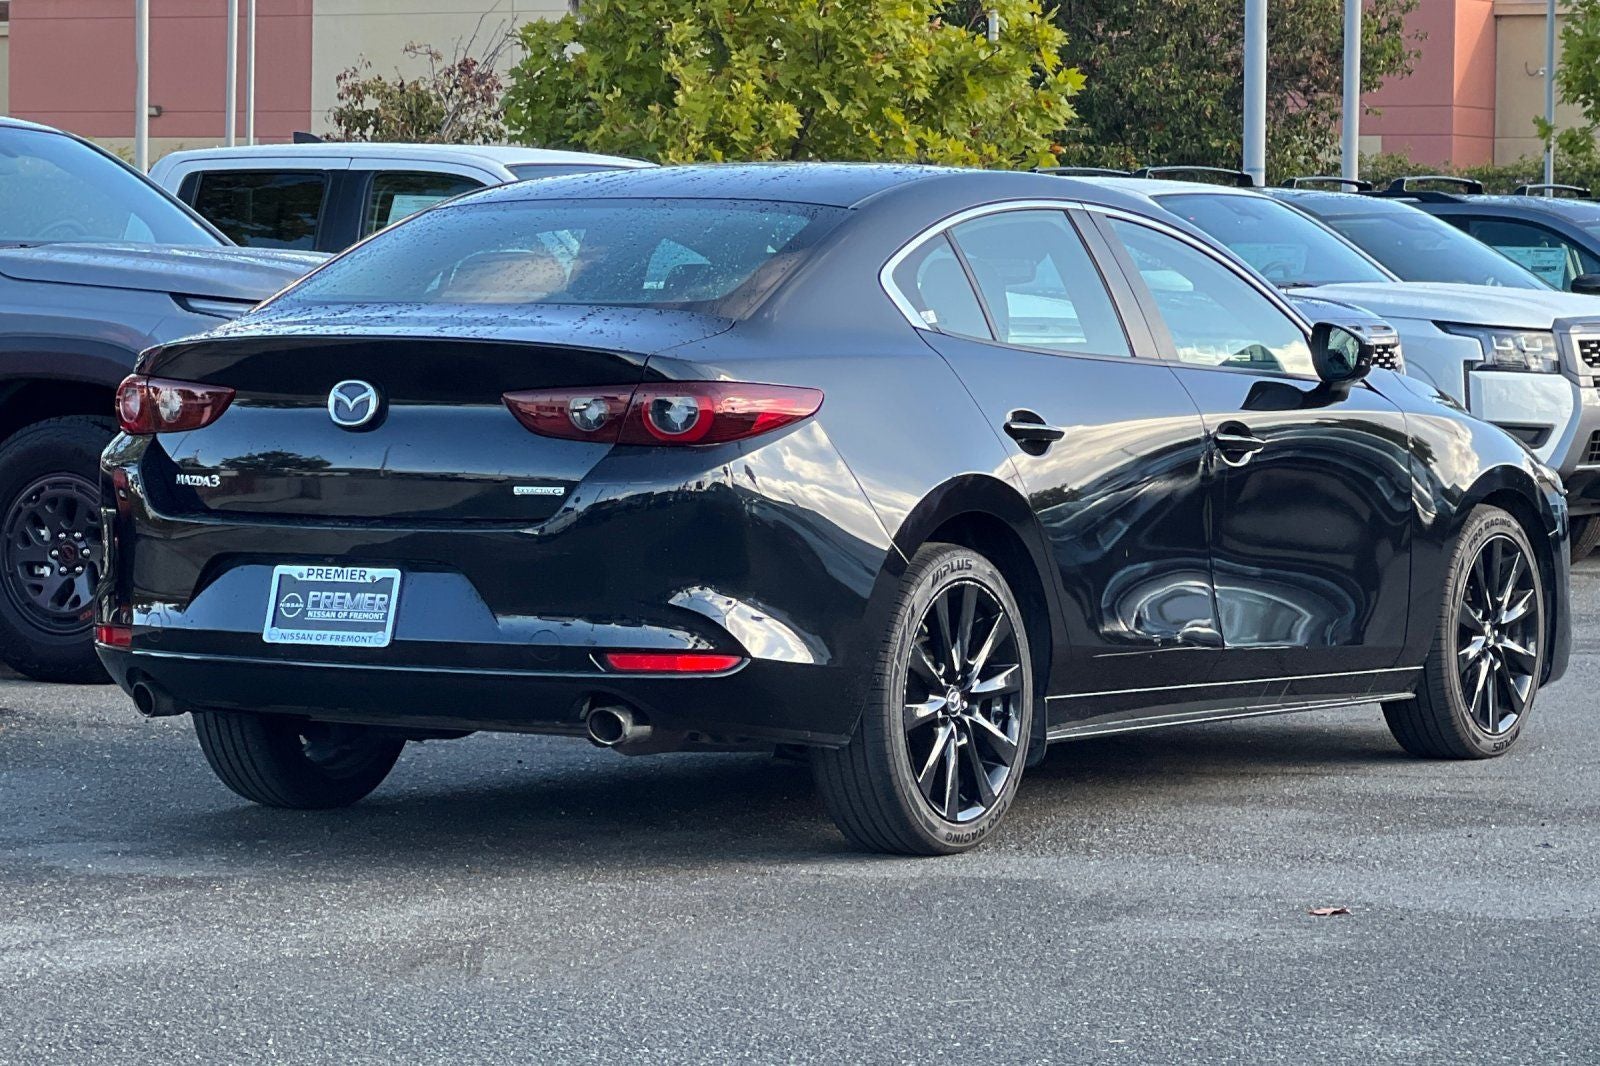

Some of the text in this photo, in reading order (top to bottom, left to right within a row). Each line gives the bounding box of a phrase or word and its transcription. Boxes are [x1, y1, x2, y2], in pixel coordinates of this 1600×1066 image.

[1468, 517, 1512, 551] PRO RACING
[306, 568, 367, 580] PREMIER
[307, 591, 389, 611] PREMIER
[307, 610, 385, 620] NISSAN OF FREMONT
[280, 632, 373, 643] NISSAN OF FREMONT
[945, 799, 1007, 843] PRO RACING
